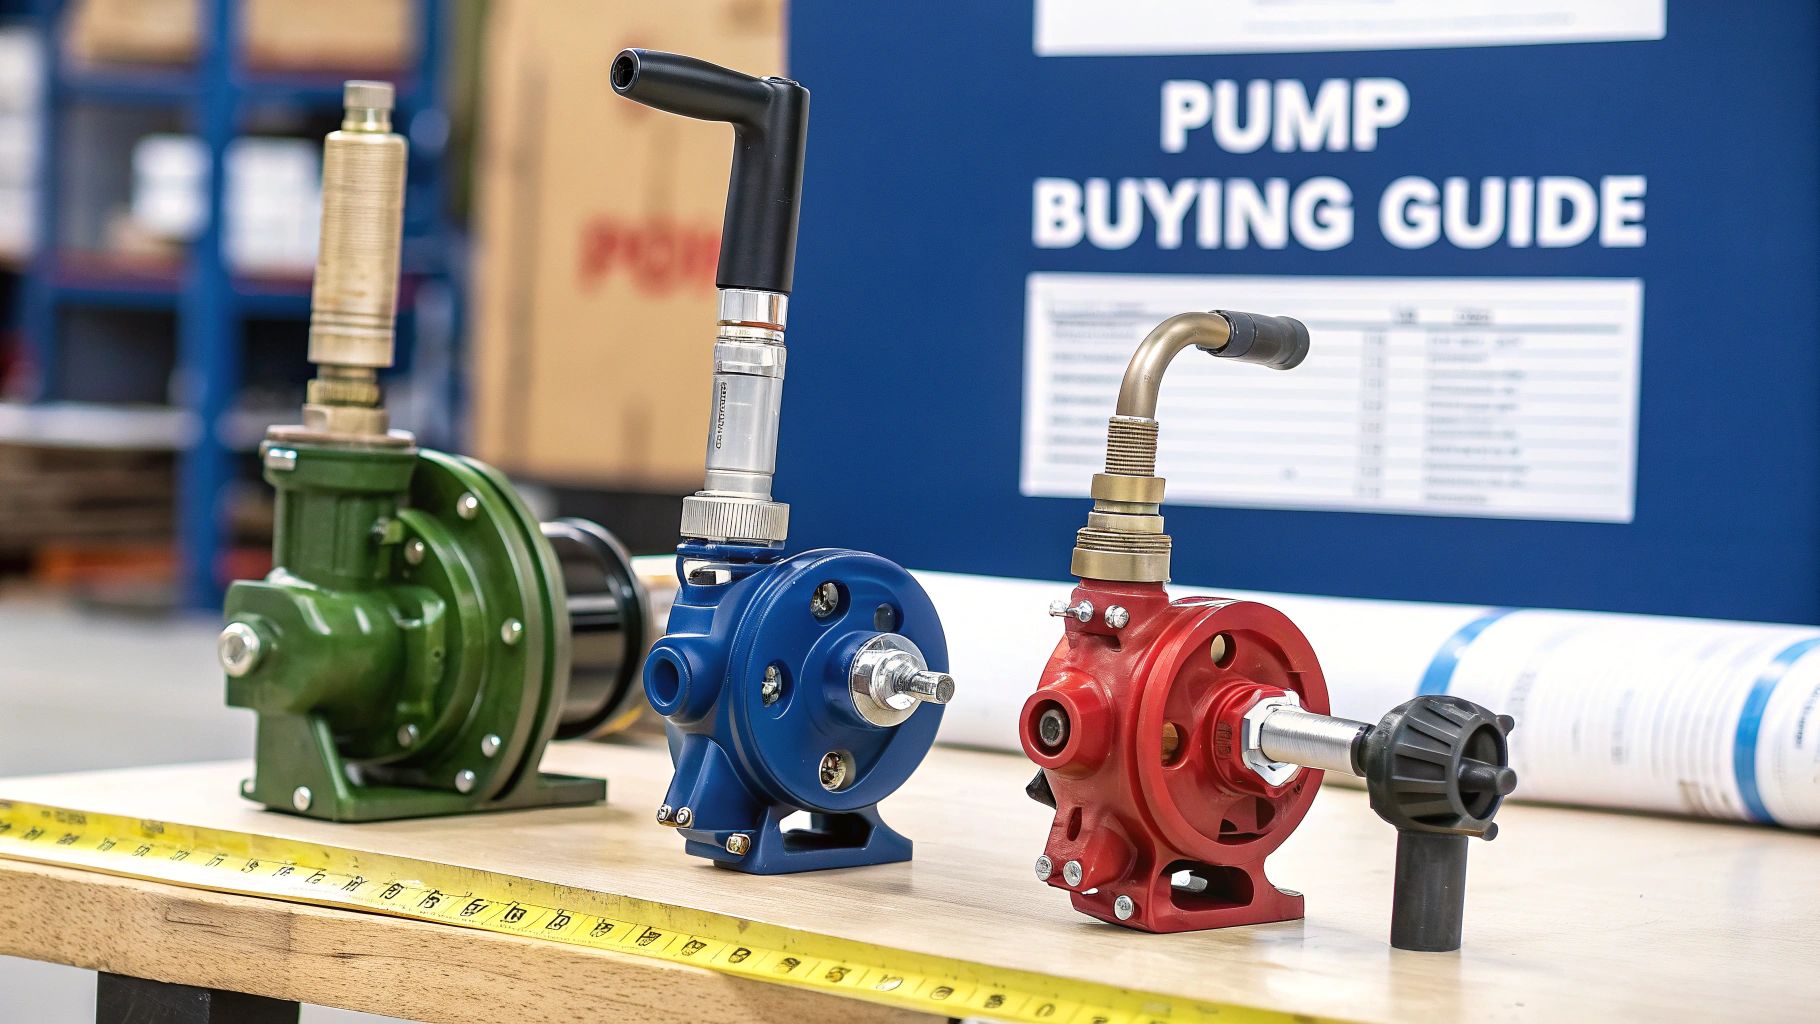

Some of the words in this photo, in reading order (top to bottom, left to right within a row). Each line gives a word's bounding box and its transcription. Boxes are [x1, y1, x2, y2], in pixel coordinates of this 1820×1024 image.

[1161, 78, 1409, 153] PUMP
[1033, 177, 1353, 250] BUYING
[1380, 176, 1646, 249] GUIDE
